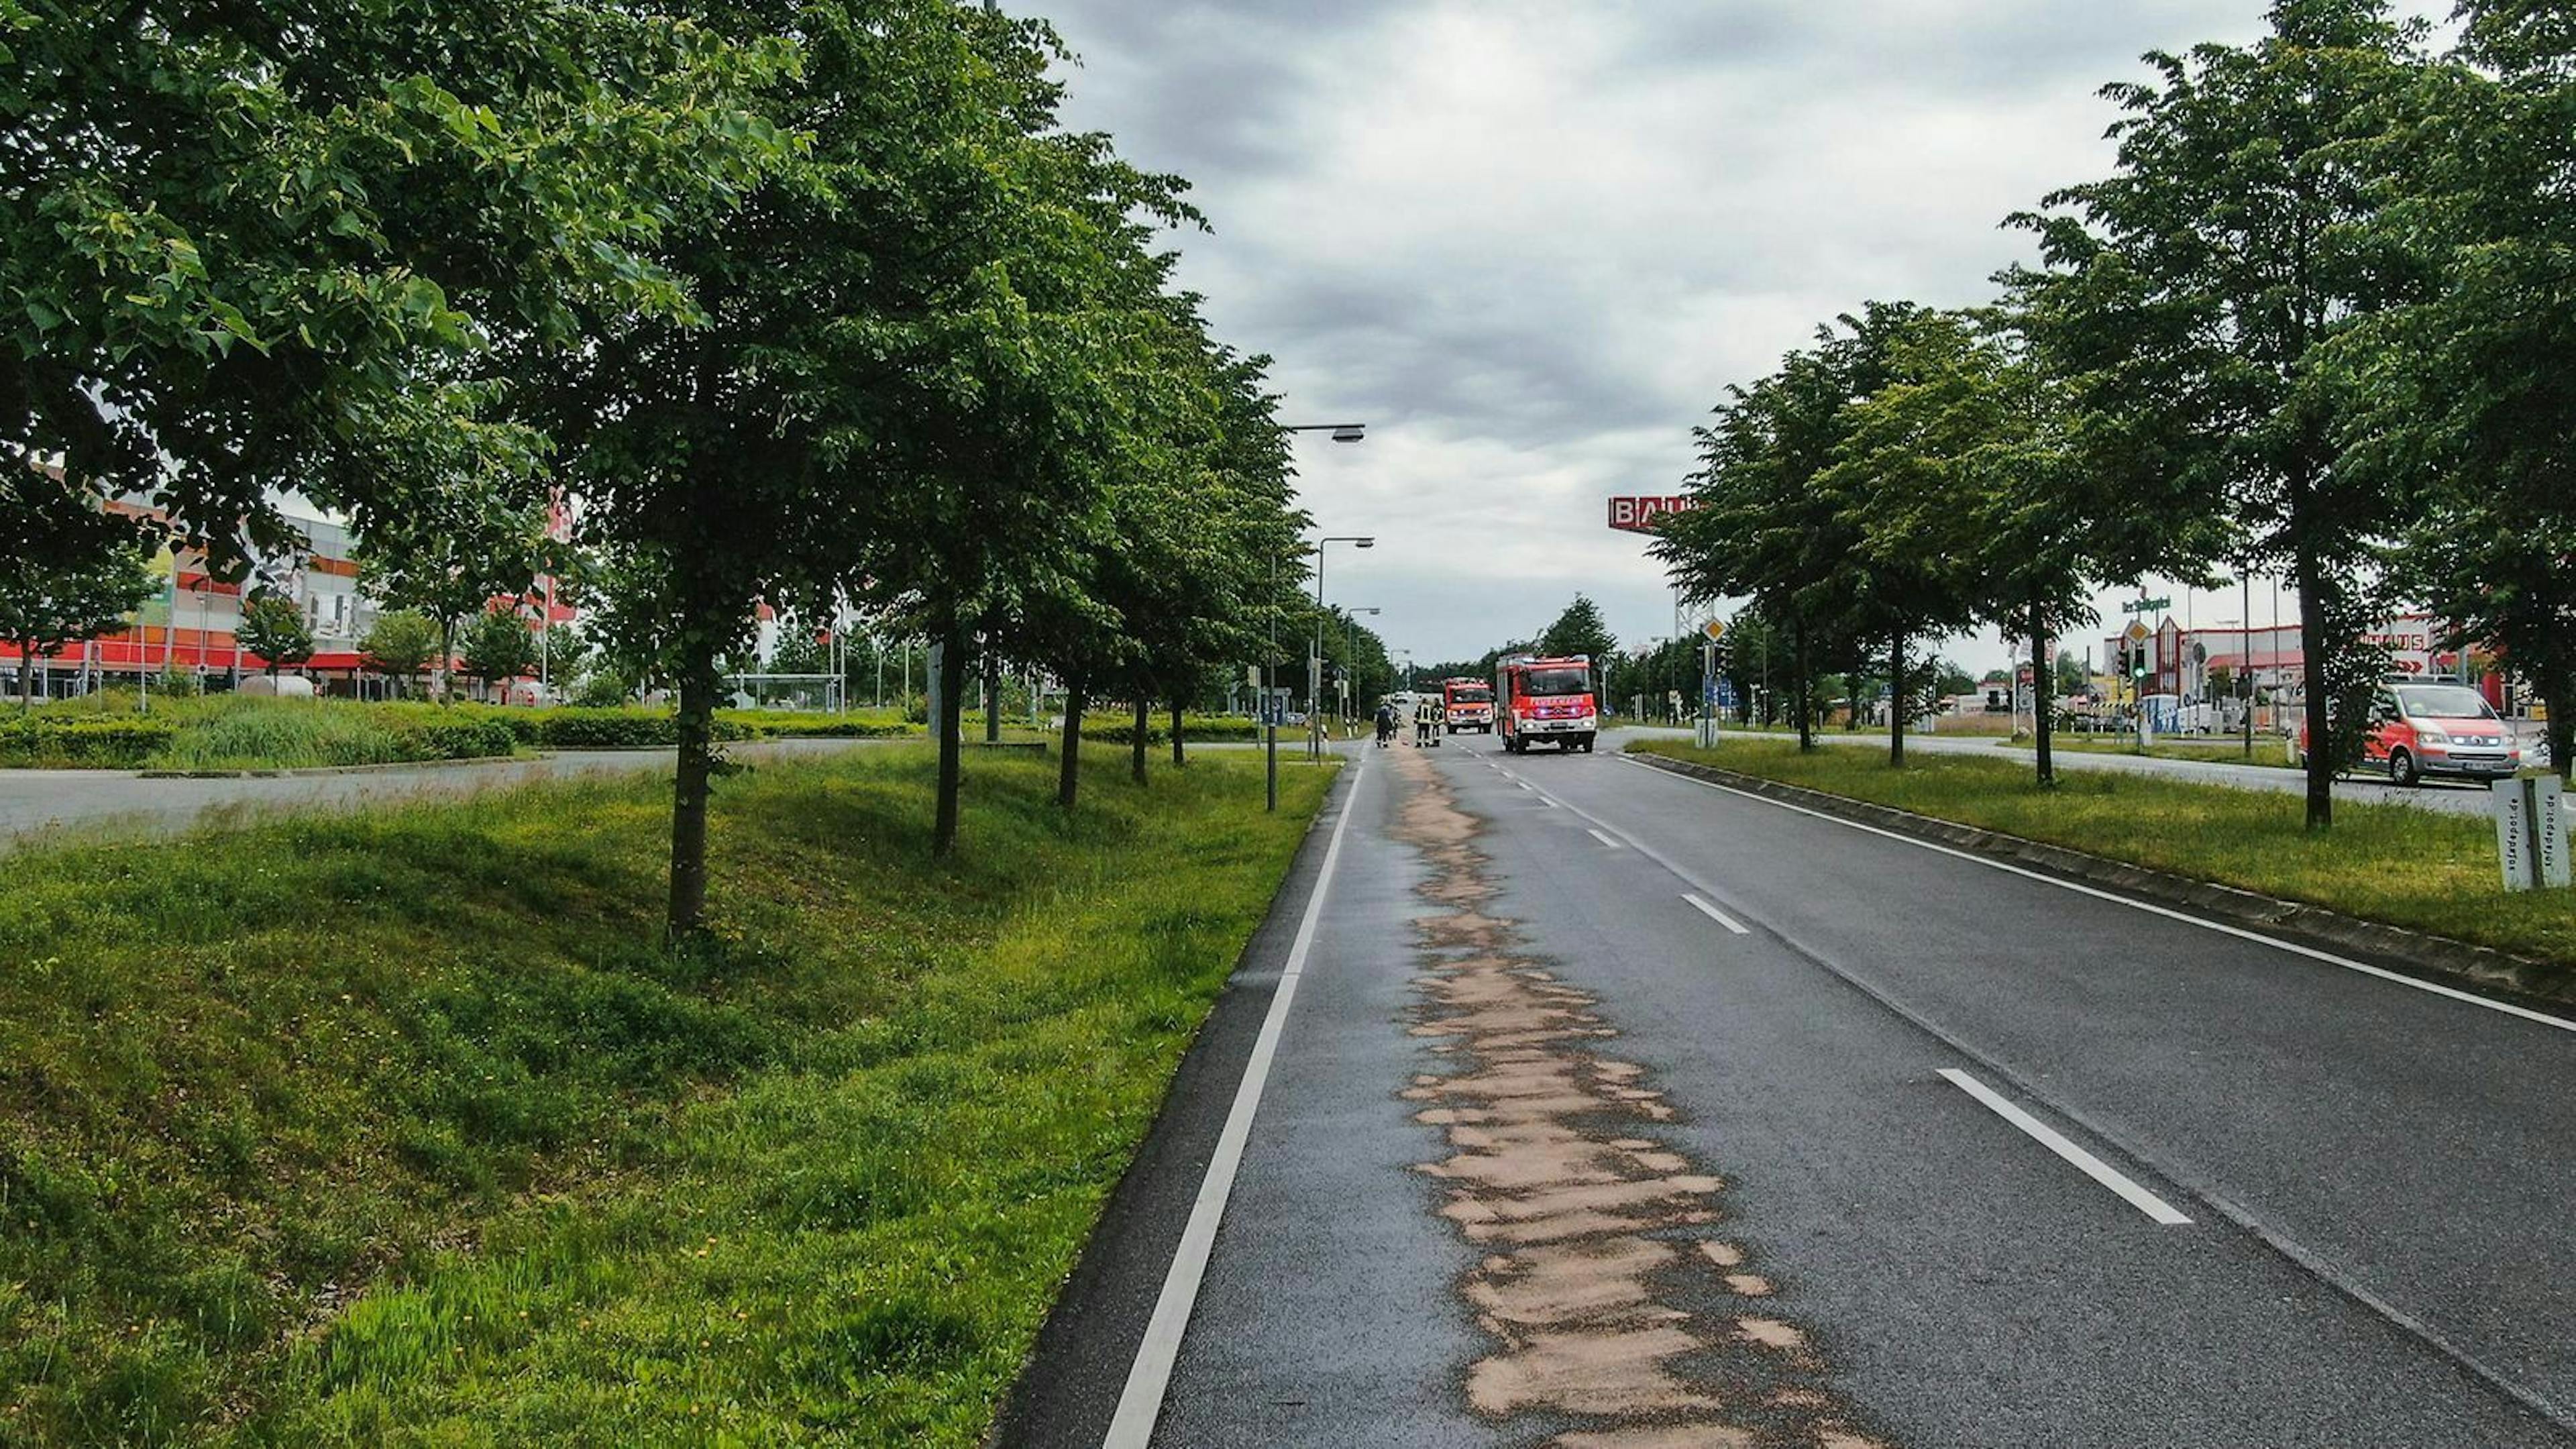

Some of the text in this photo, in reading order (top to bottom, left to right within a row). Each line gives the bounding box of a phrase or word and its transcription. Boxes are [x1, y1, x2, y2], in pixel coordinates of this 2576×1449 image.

[1615, 500, 1699, 523] BAU
[2359, 633, 2424, 651] HAUS
[2506, 798, 2518, 870] sofadepot.de
